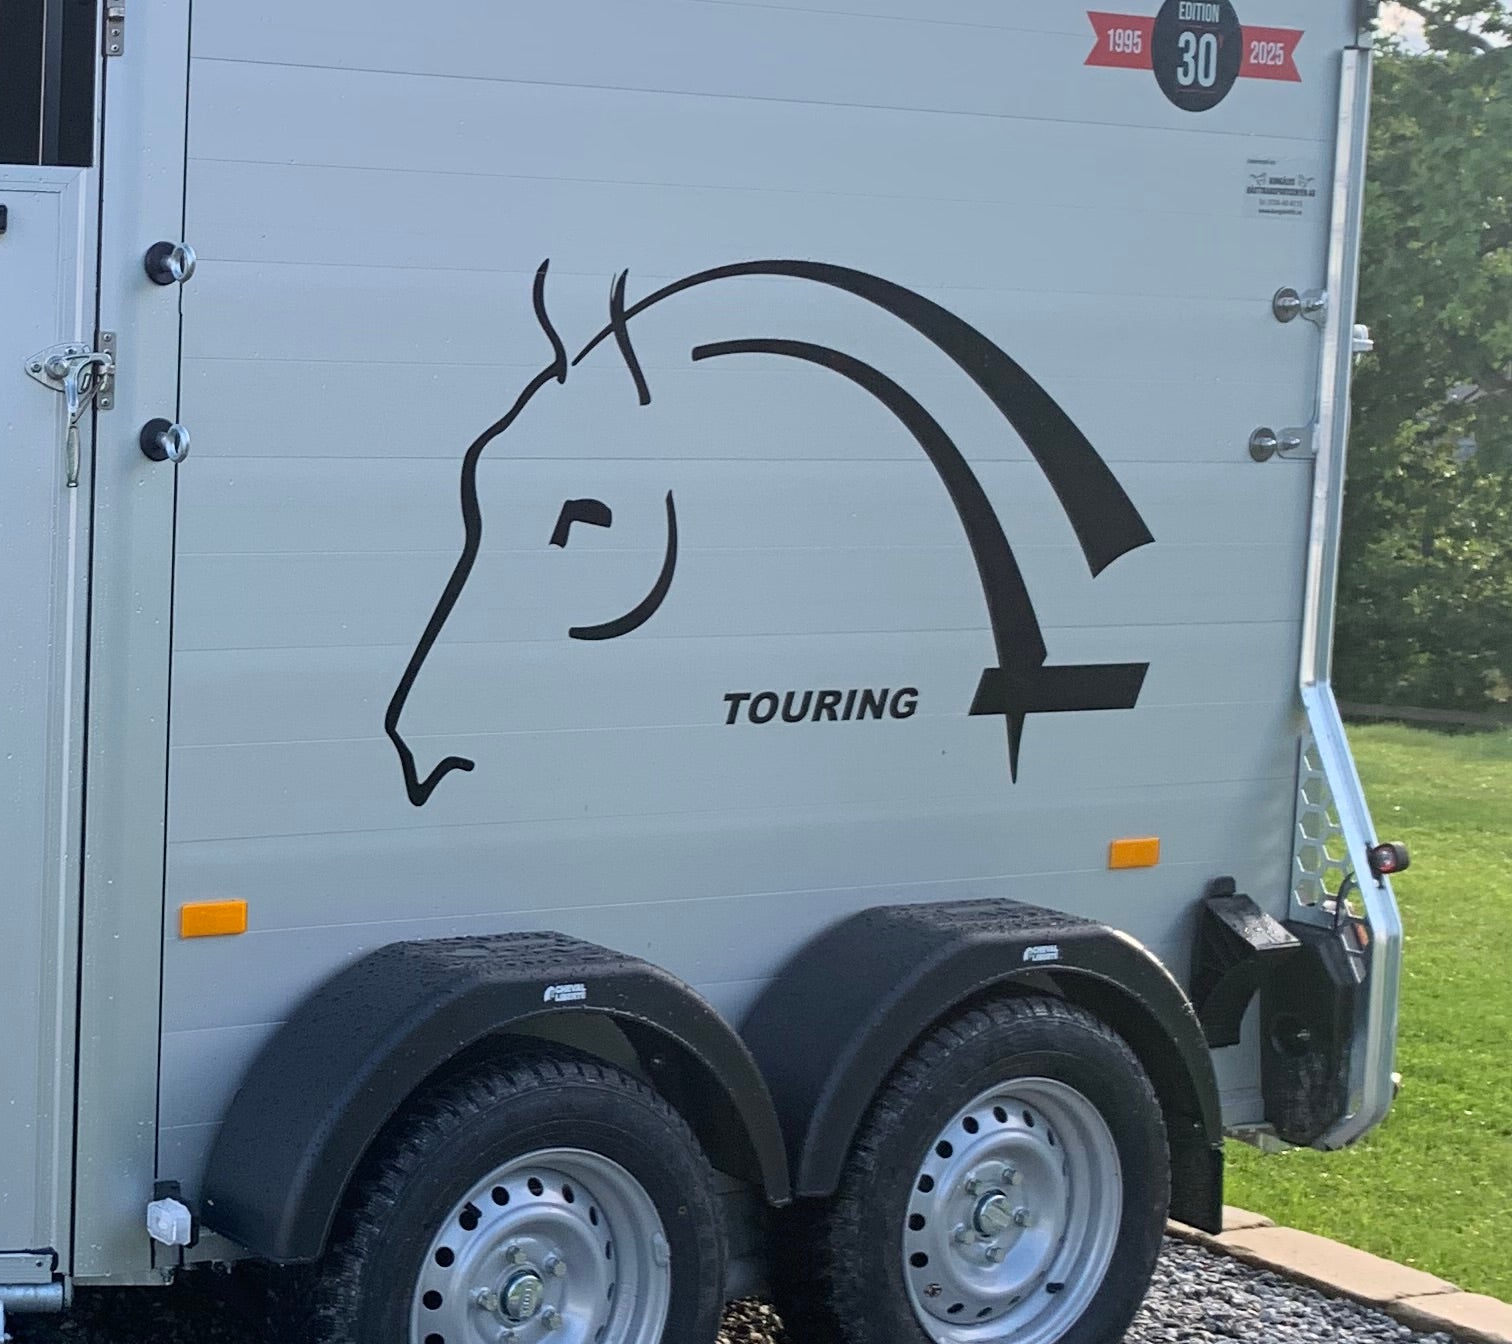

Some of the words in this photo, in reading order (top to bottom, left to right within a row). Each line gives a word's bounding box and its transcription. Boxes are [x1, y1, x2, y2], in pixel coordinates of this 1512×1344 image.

[1178, 1, 1220, 23] EDITION
[1107, 28, 1142, 54] 1995
[1250, 41, 1284, 65] 2025
[1177, 31, 1218, 88] 30
[723, 687, 919, 725] TOURING
